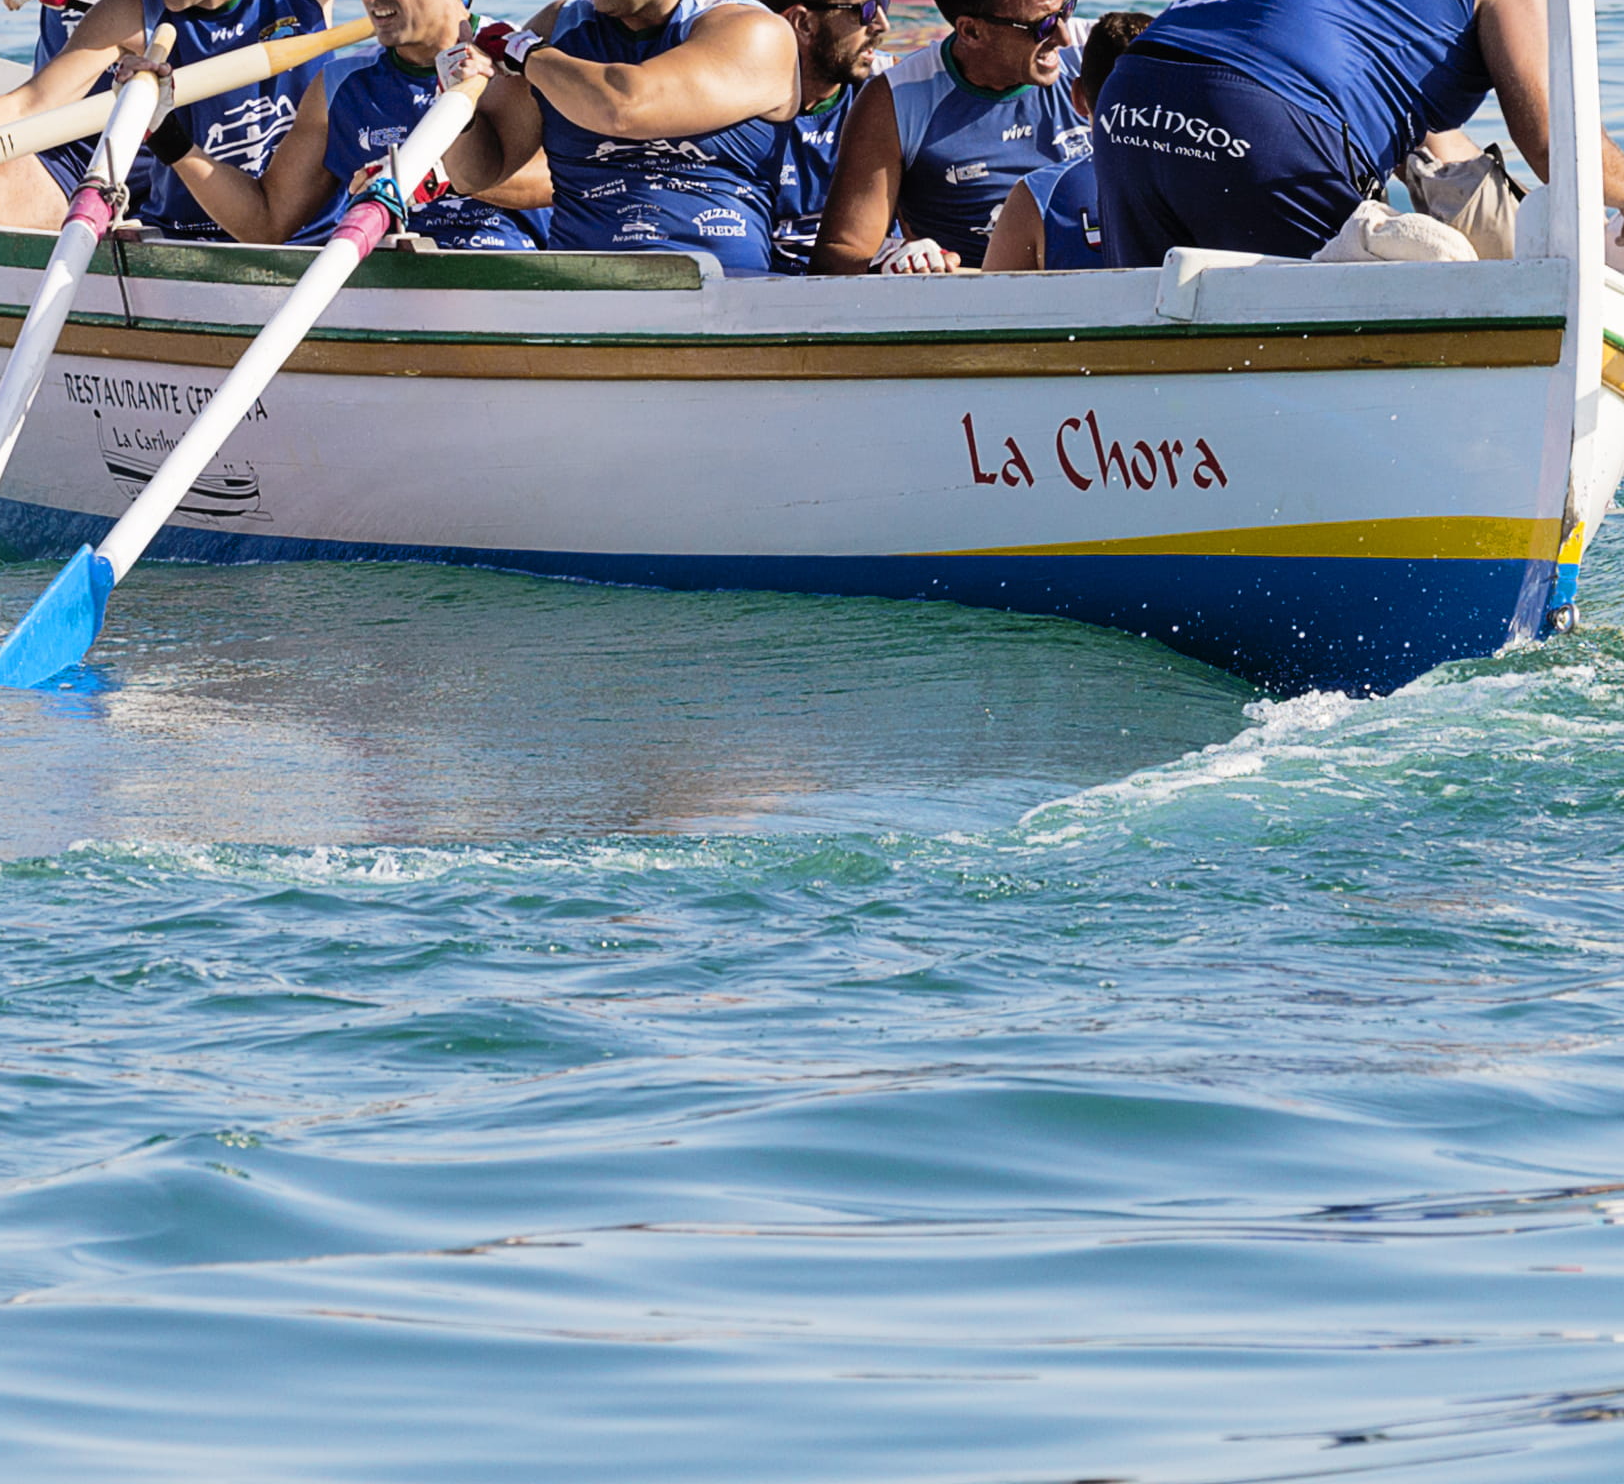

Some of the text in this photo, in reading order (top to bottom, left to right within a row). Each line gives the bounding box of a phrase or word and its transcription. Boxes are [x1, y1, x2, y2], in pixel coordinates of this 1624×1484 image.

[802, 131, 835, 145] vive
[1002, 124, 1033, 143] vive
[699, 225, 747, 237] FREDES
[64, 372, 182, 415] RESTAURANTE
[113, 427, 132, 449] La
[960, 409, 1228, 492] La Chora
